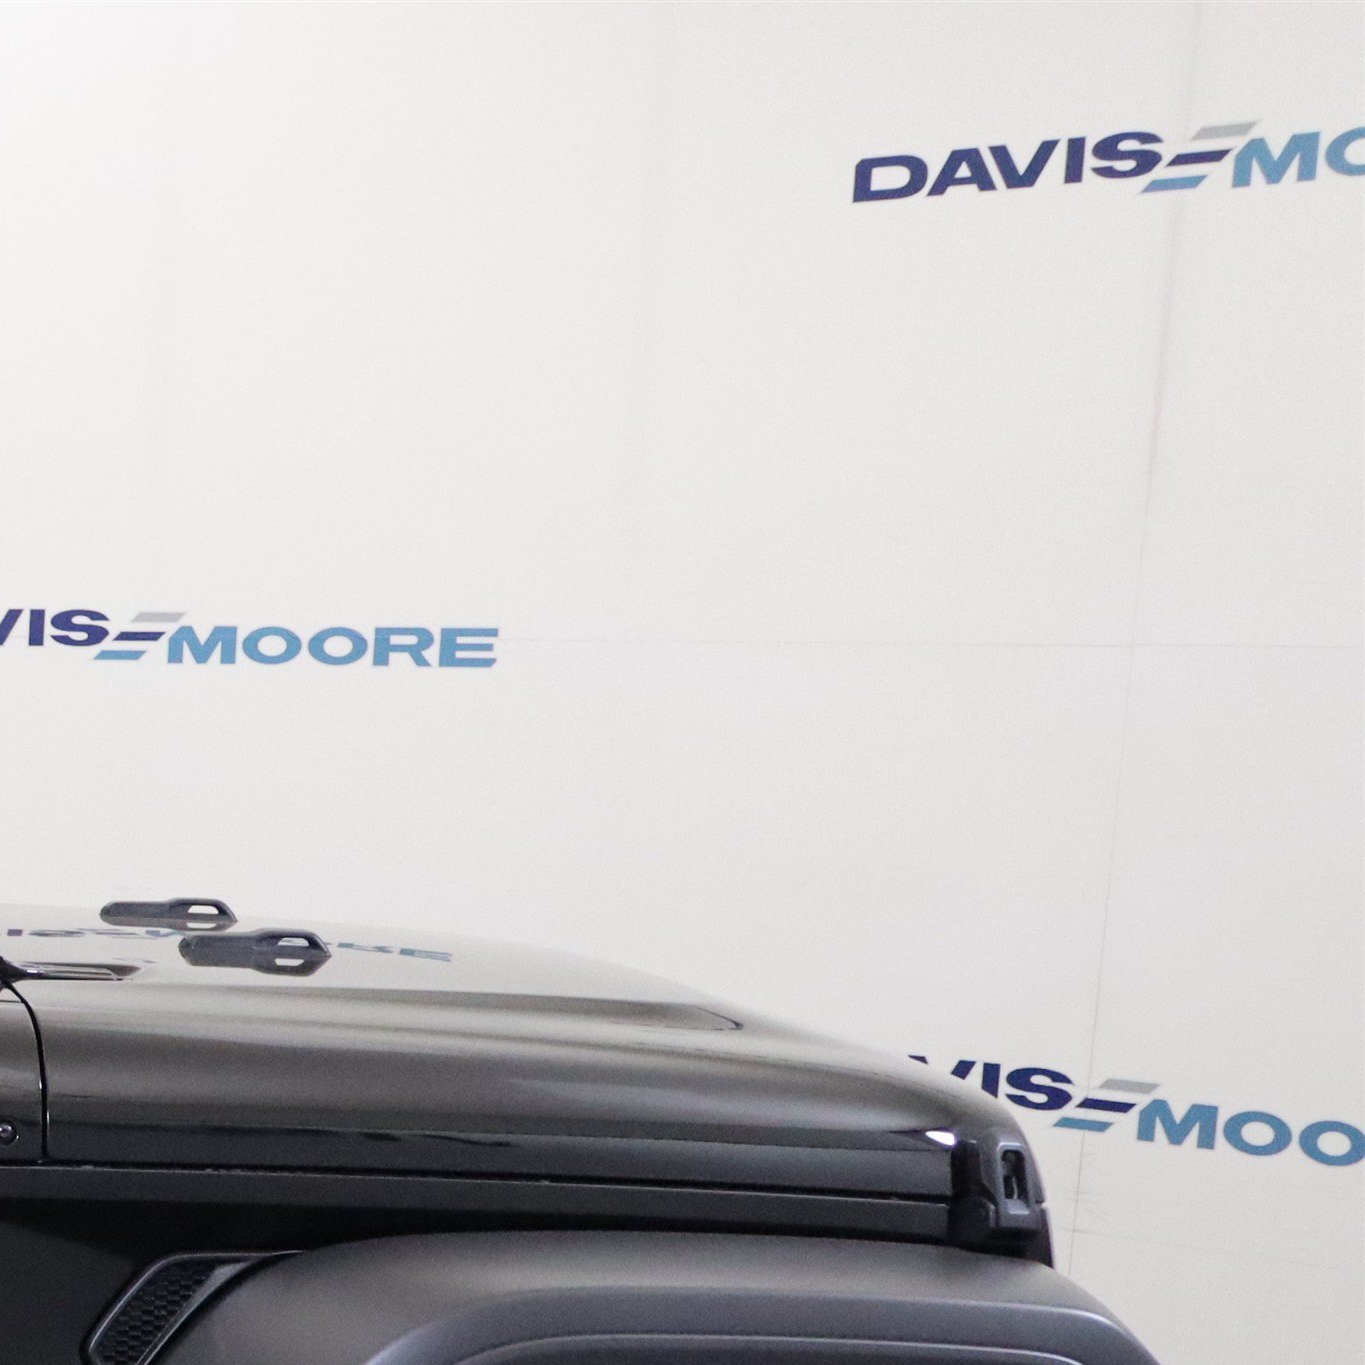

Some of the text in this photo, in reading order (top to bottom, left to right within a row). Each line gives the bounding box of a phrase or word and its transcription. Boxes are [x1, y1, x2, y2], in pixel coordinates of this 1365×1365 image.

[852, 129, 1163, 202] DAVIS
[165, 623, 500, 669] MOORE
[1136, 1097, 1365, 1168] MOO
